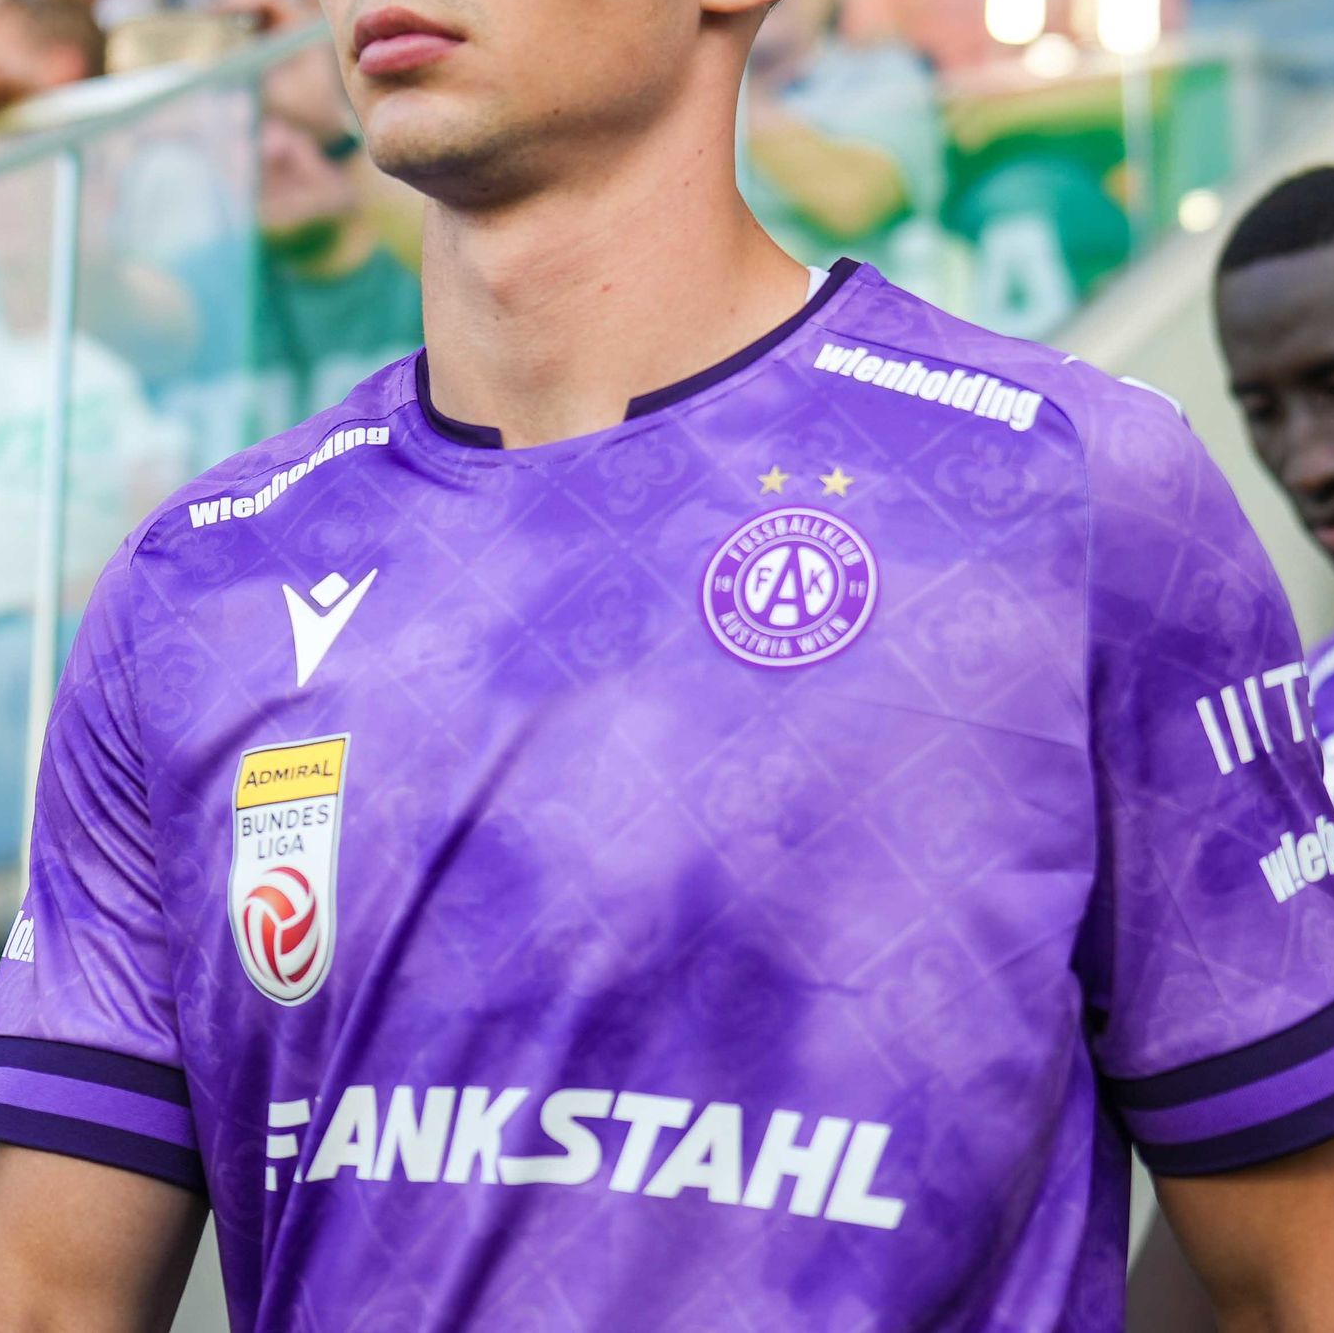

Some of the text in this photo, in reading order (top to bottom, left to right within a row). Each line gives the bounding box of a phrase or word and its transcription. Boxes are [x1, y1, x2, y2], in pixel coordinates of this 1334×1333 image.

[243, 760, 334, 790] ADMIRAL
[241, 804, 329, 837] BUNDES
[257, 834, 305, 860] LIGA
